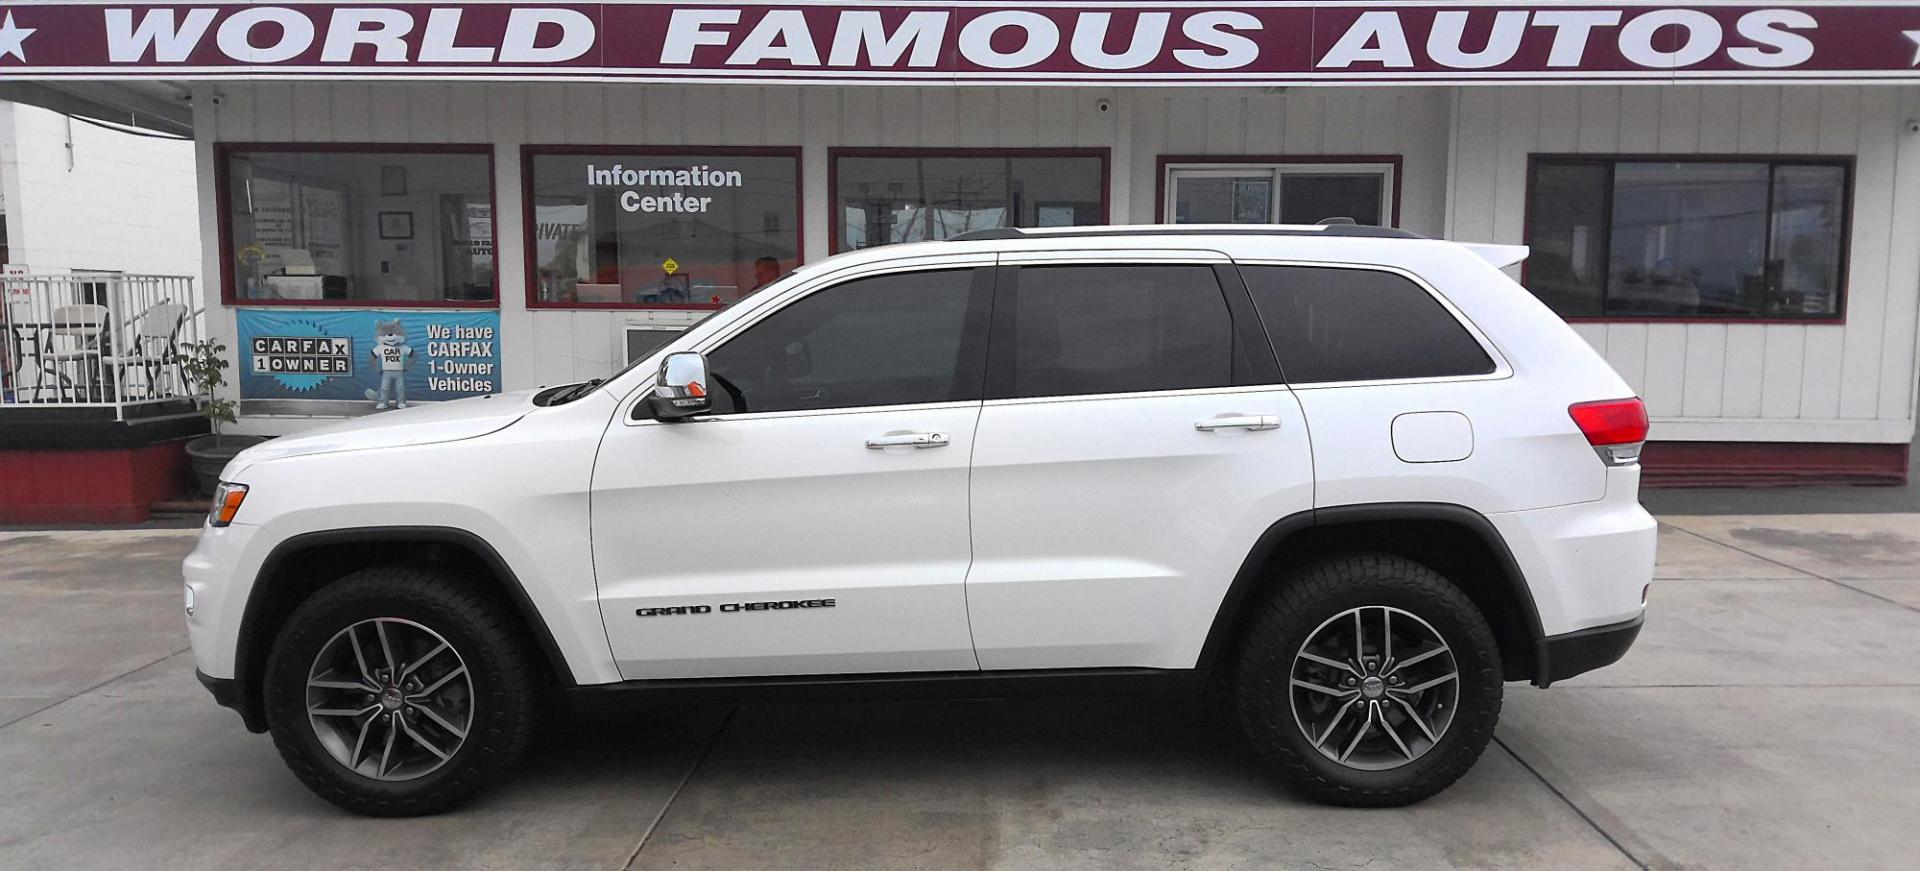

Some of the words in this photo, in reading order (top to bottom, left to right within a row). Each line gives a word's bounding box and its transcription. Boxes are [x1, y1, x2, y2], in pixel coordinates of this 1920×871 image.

[104, 7, 595, 63] WORLD
[660, 8, 1263, 69] FAMOUS
[1316, 9, 1818, 68] AUTOS
[587, 164, 742, 187] Information
[620, 191, 712, 213] Center
[427, 324, 450, 339] We
[455, 324, 493, 339] have
[255, 339, 348, 355] CARFAX
[427, 341, 493, 357] CARFAX
[385, 355, 400, 363] FOX
[428, 359, 494, 375] 1-Owner
[428, 377, 493, 392] Vehicles
[635, 605, 712, 617] GRAND
[719, 598, 836, 613] CHEROKEE
